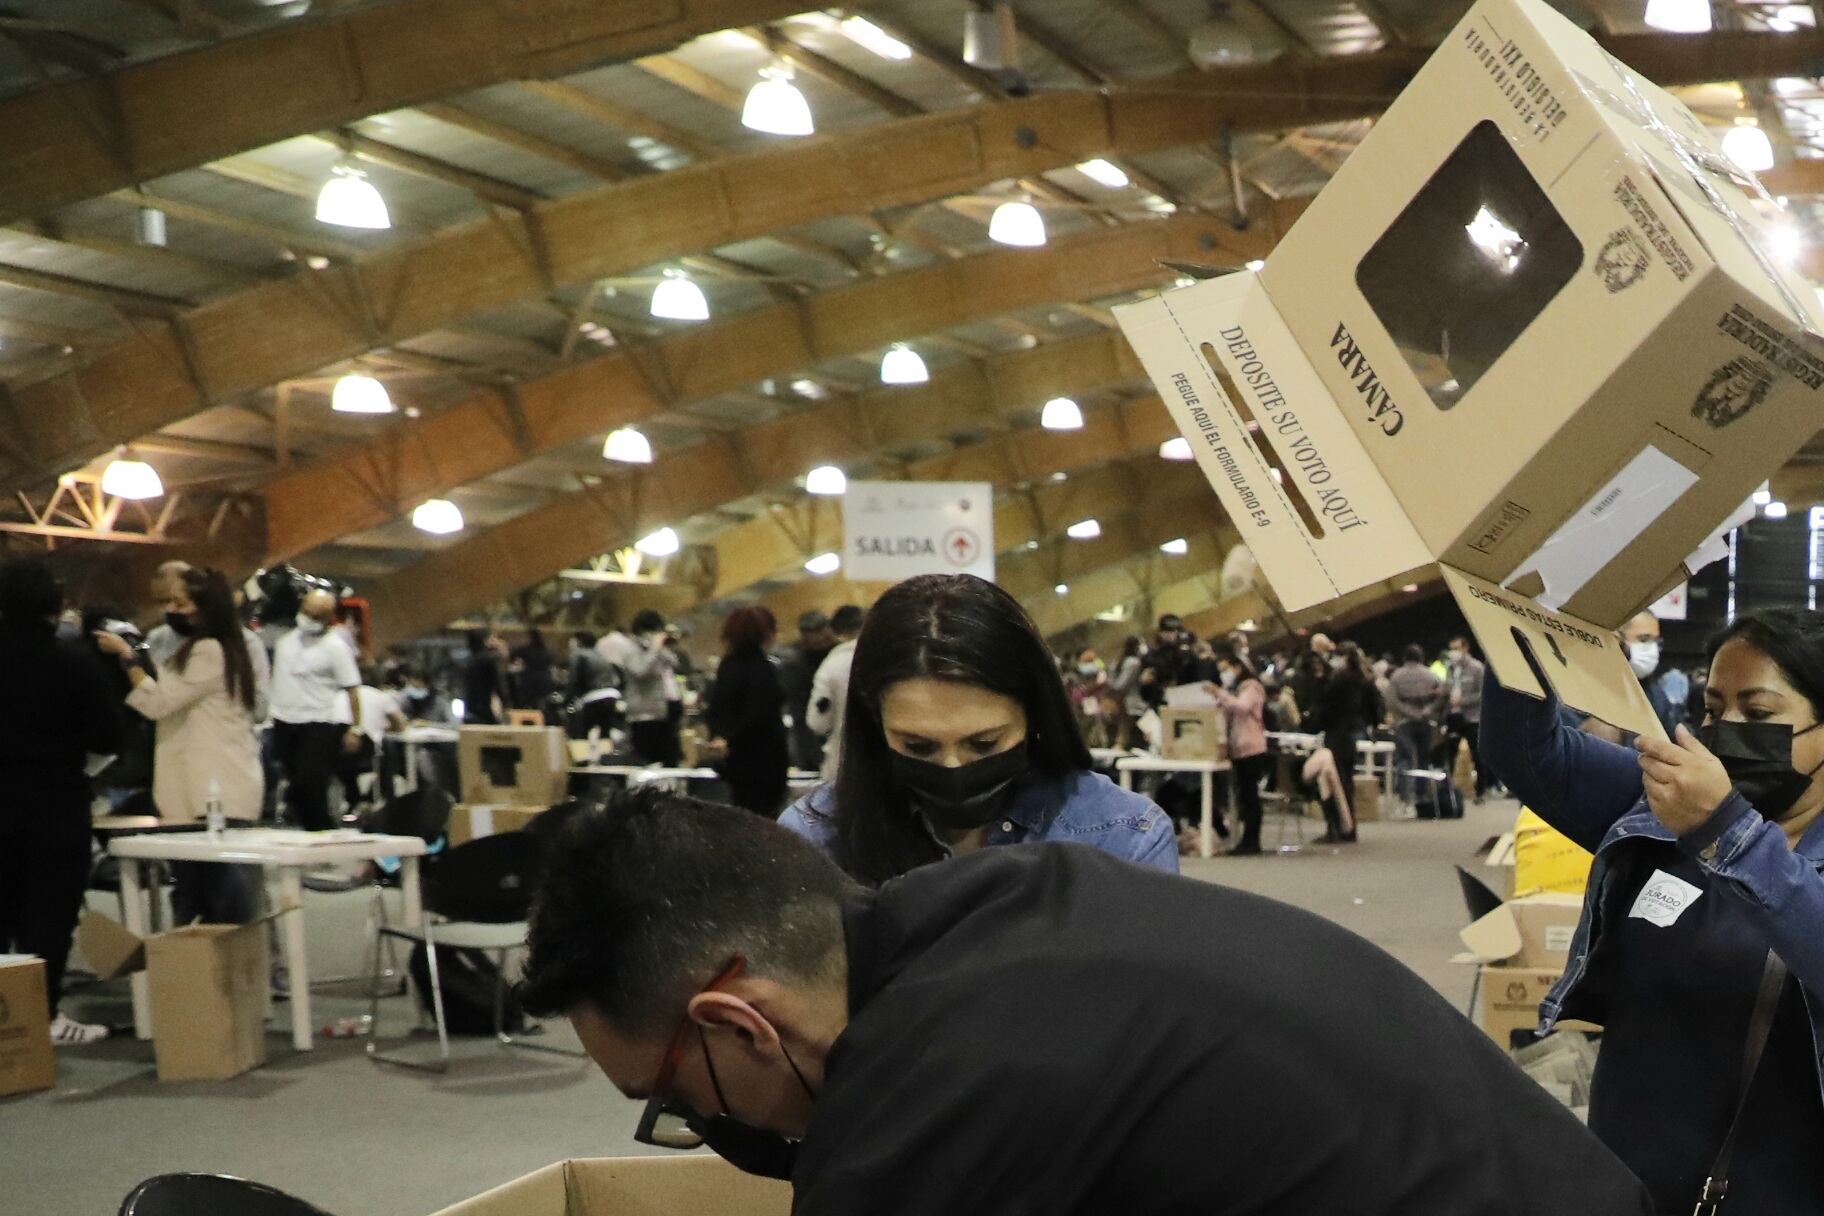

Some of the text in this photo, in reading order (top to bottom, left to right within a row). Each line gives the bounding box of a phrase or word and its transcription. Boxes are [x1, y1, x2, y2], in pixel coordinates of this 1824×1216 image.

[1329, 321, 1405, 437] CÁMARA
[1219, 324, 1368, 533] DEPOSITE SU VOTO AQUÍ
[1170, 370, 1272, 529] PEGUE AQUÍ EL FORMULARIO E-9
[855, 535, 936, 556] SALIDA
[1468, 585, 1526, 617] PRIMERO
[1563, 623, 1603, 649] DOBLE
[1645, 889, 1680, 907] JURADO
